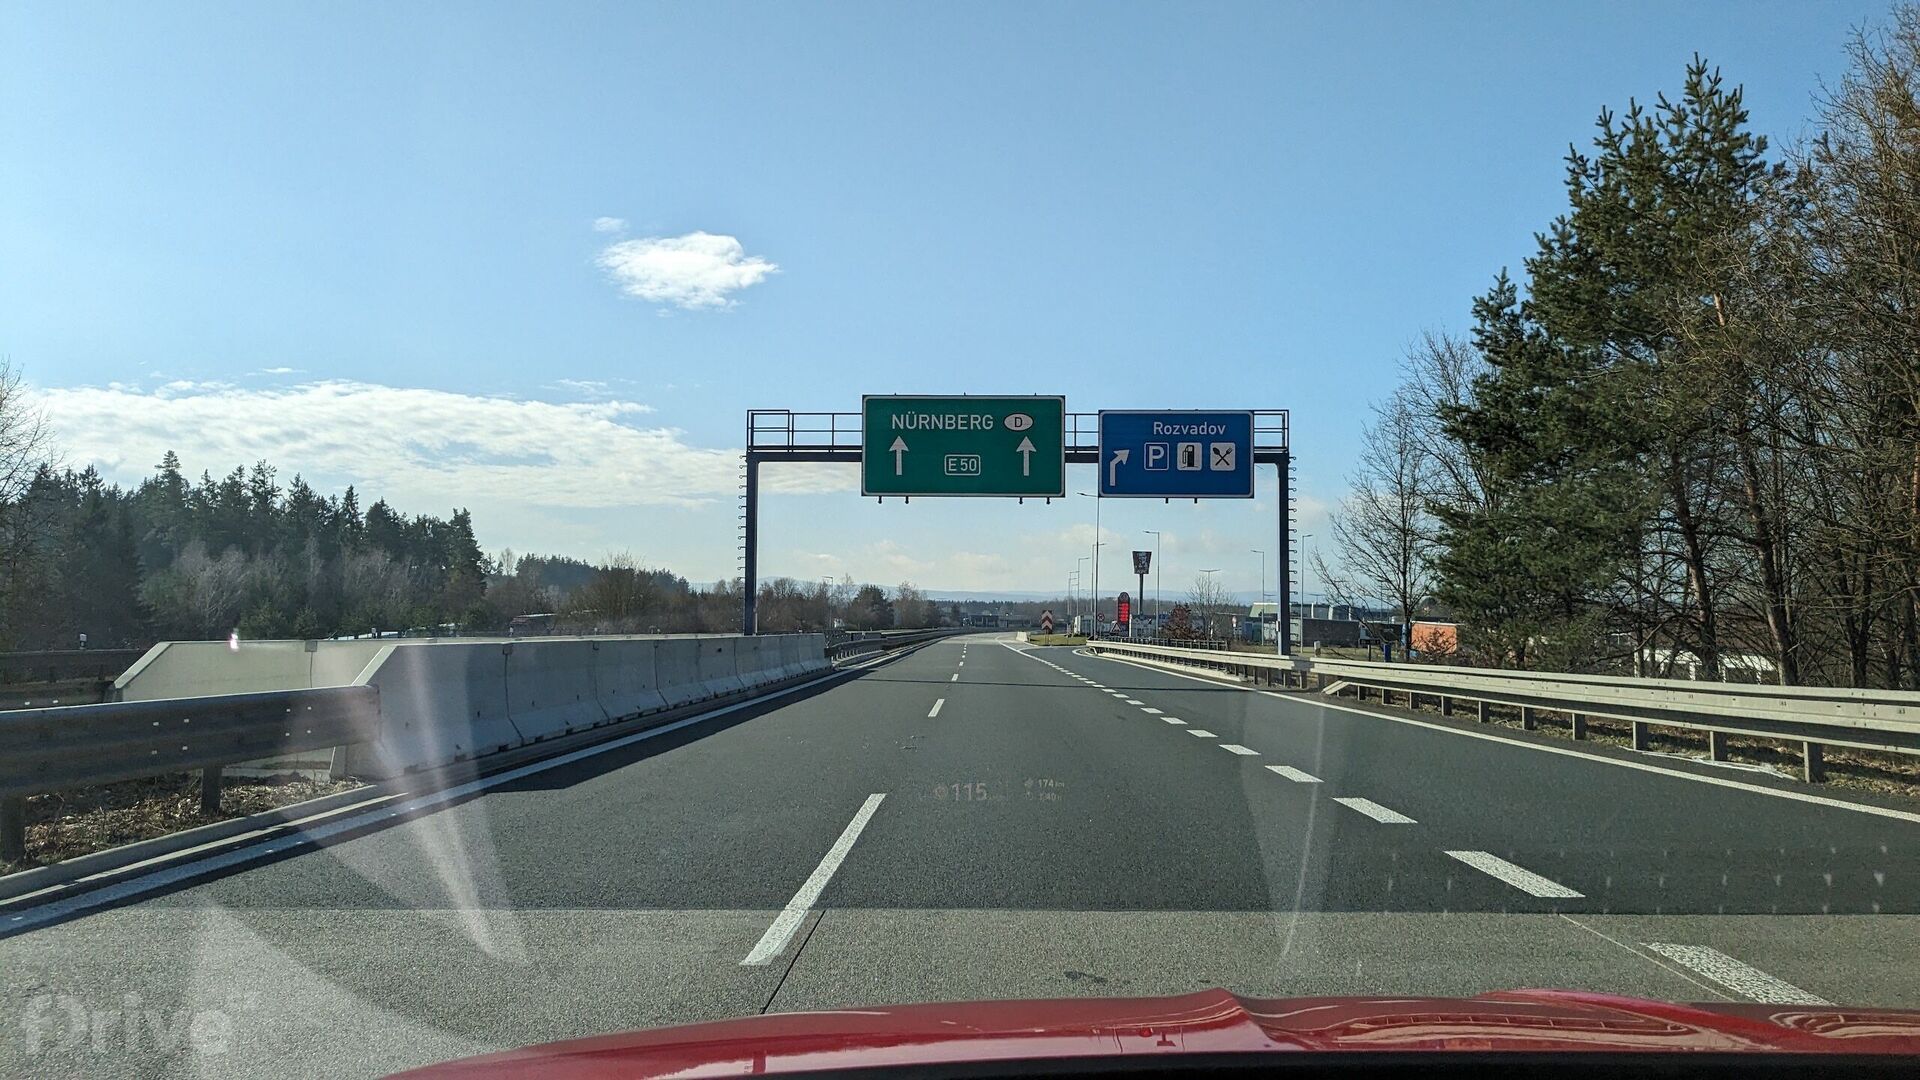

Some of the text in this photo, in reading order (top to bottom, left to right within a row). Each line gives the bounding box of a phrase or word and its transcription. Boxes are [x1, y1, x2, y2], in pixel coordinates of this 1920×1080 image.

[891, 411, 1023, 430] NÜRNBERG D
[1153, 421, 1226, 435] Rozvadov
[948, 458, 977, 472] E 50
[1148, 445, 1165, 468] P
[951, 782, 988, 801] 115
